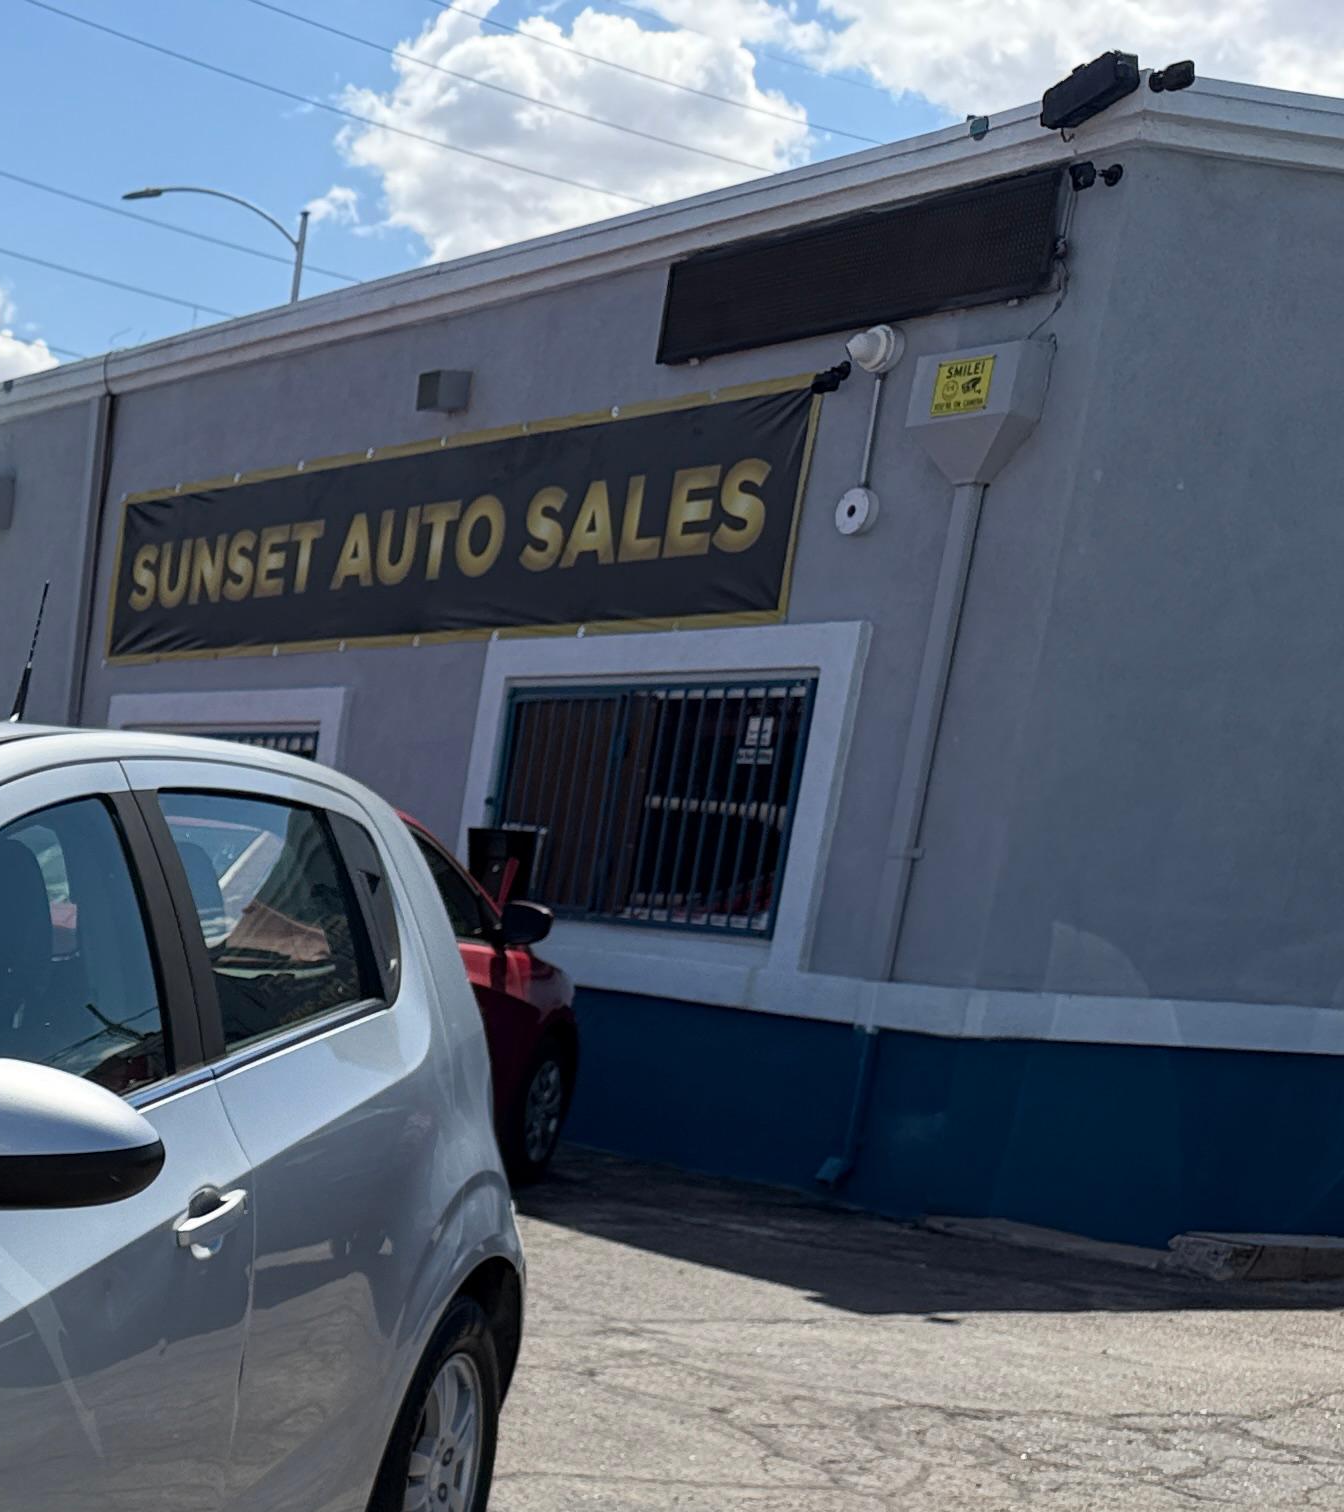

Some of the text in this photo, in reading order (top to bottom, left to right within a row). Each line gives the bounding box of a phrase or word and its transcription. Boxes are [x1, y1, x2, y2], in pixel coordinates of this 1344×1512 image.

[946, 361, 986, 379] SMILE!
[128, 458, 772, 612] SUNSET AUTO SALES
